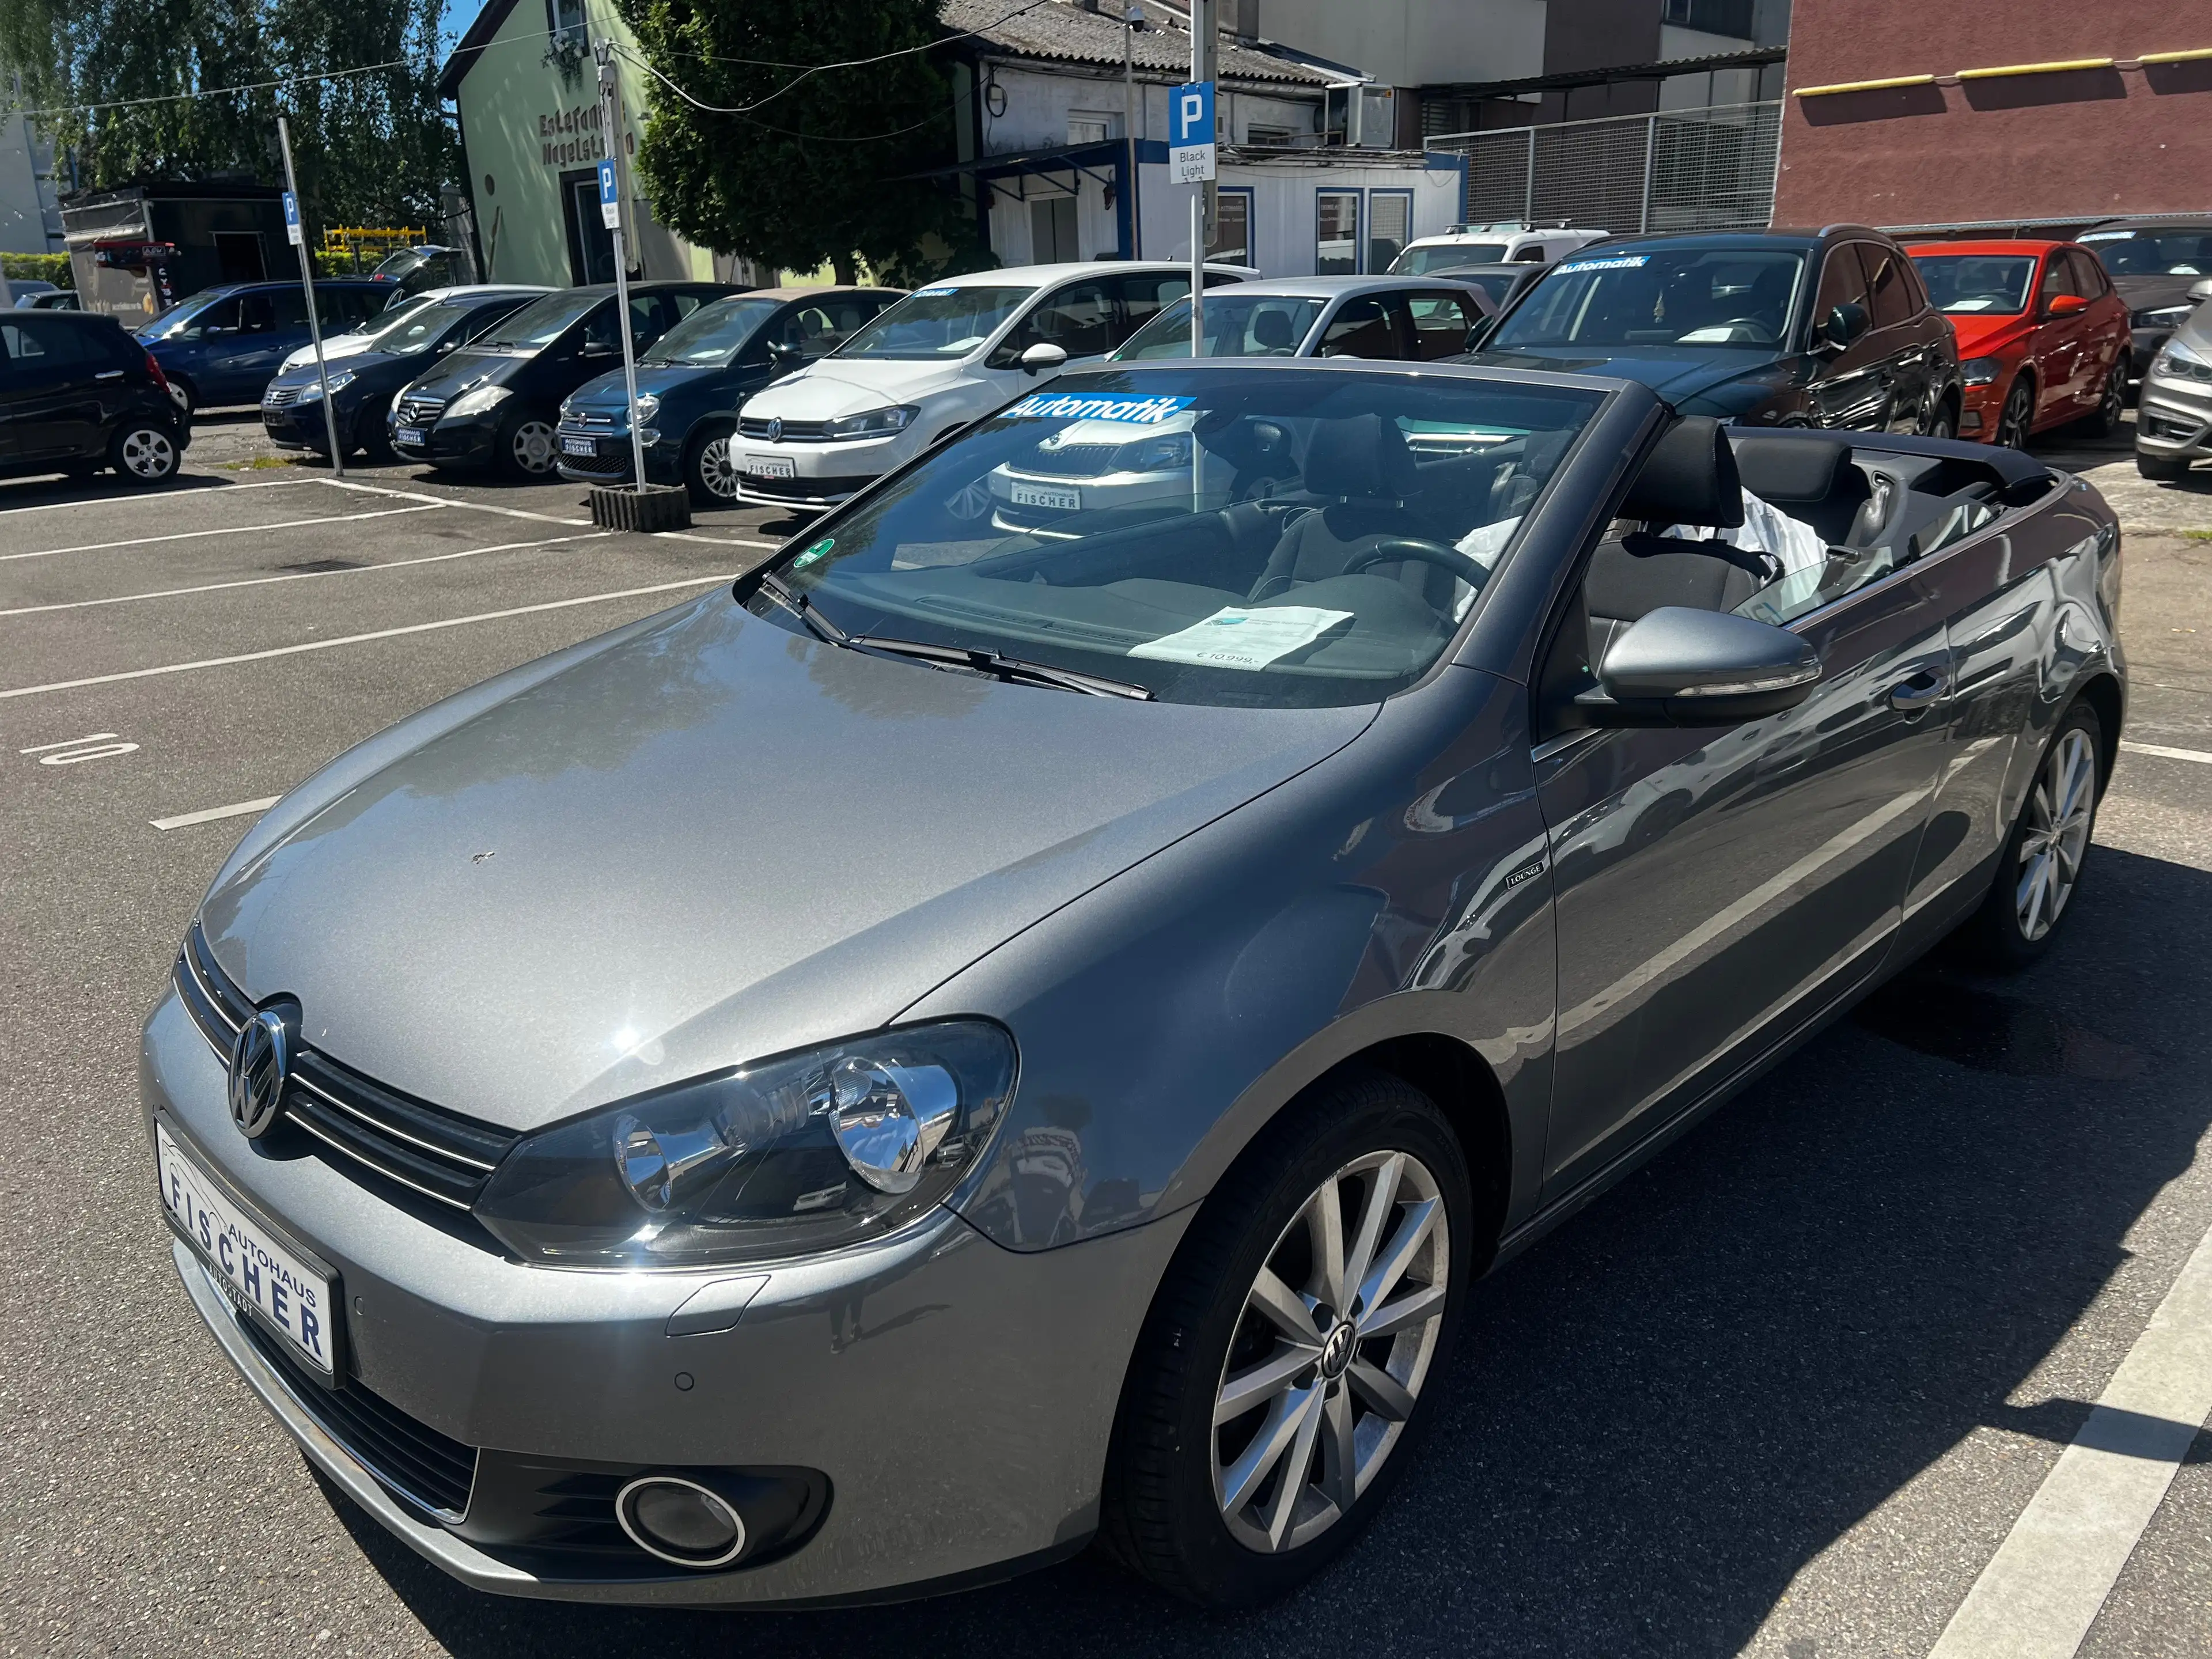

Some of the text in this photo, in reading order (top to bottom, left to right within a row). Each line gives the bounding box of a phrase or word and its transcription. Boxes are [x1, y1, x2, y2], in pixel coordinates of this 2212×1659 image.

[1181, 94, 1203, 139] P
[542, 131, 635, 168] Nagelsto
[1180, 150, 1206, 163] Black
[601, 168, 612, 199] P
[1181, 164, 1205, 178] Light
[286, 197, 294, 221] P
[1551, 256, 1646, 276] Automatik
[1001, 396, 1179, 423] Automatik
[750, 465, 791, 477] FISCHER
[1017, 493, 1076, 508] FISCHER
[1509, 865, 1541, 885] LOUNGE
[171, 1172, 323, 1359] FISCHER
[228, 1222, 317, 1309] AUTOHAUS
[209, 1262, 253, 1317] AUTOSTADT
